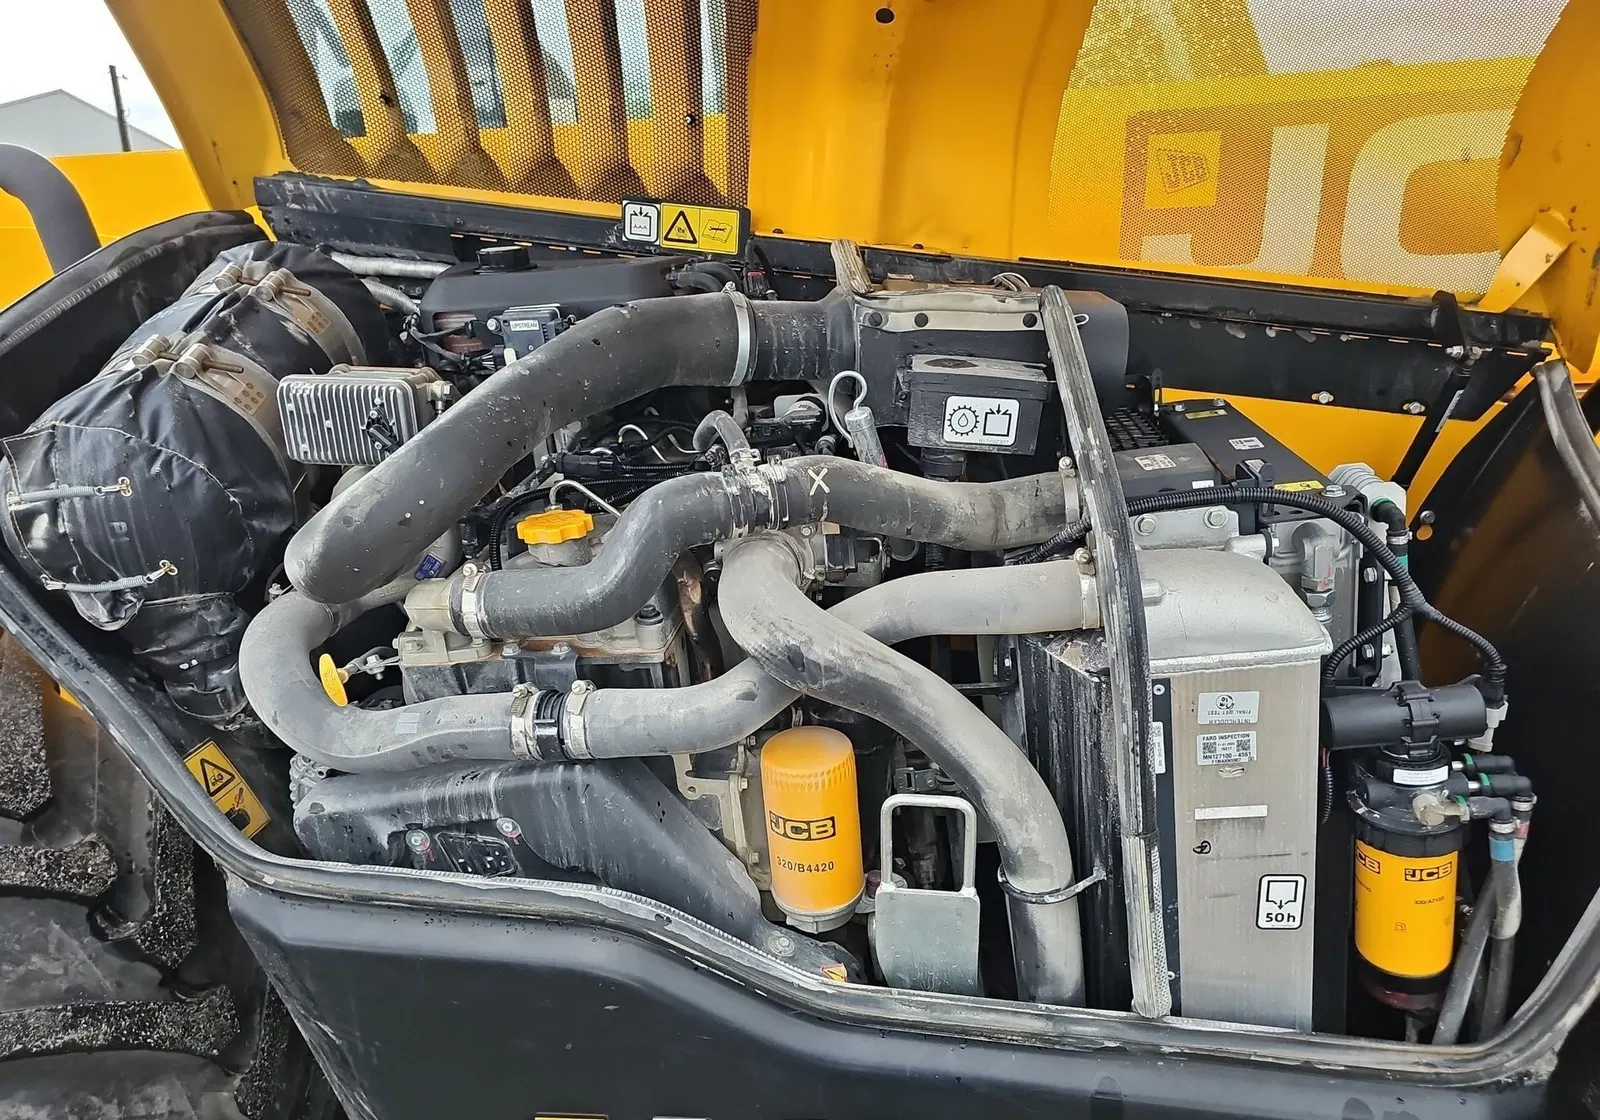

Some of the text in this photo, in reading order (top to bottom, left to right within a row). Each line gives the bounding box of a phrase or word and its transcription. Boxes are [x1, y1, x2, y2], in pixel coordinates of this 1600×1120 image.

[1218, 733, 1250, 741] INSPECTION
[770, 811, 835, 840] JCB
[776, 855, 835, 873] 320/B4420
[1405, 861, 1452, 882] JCB
